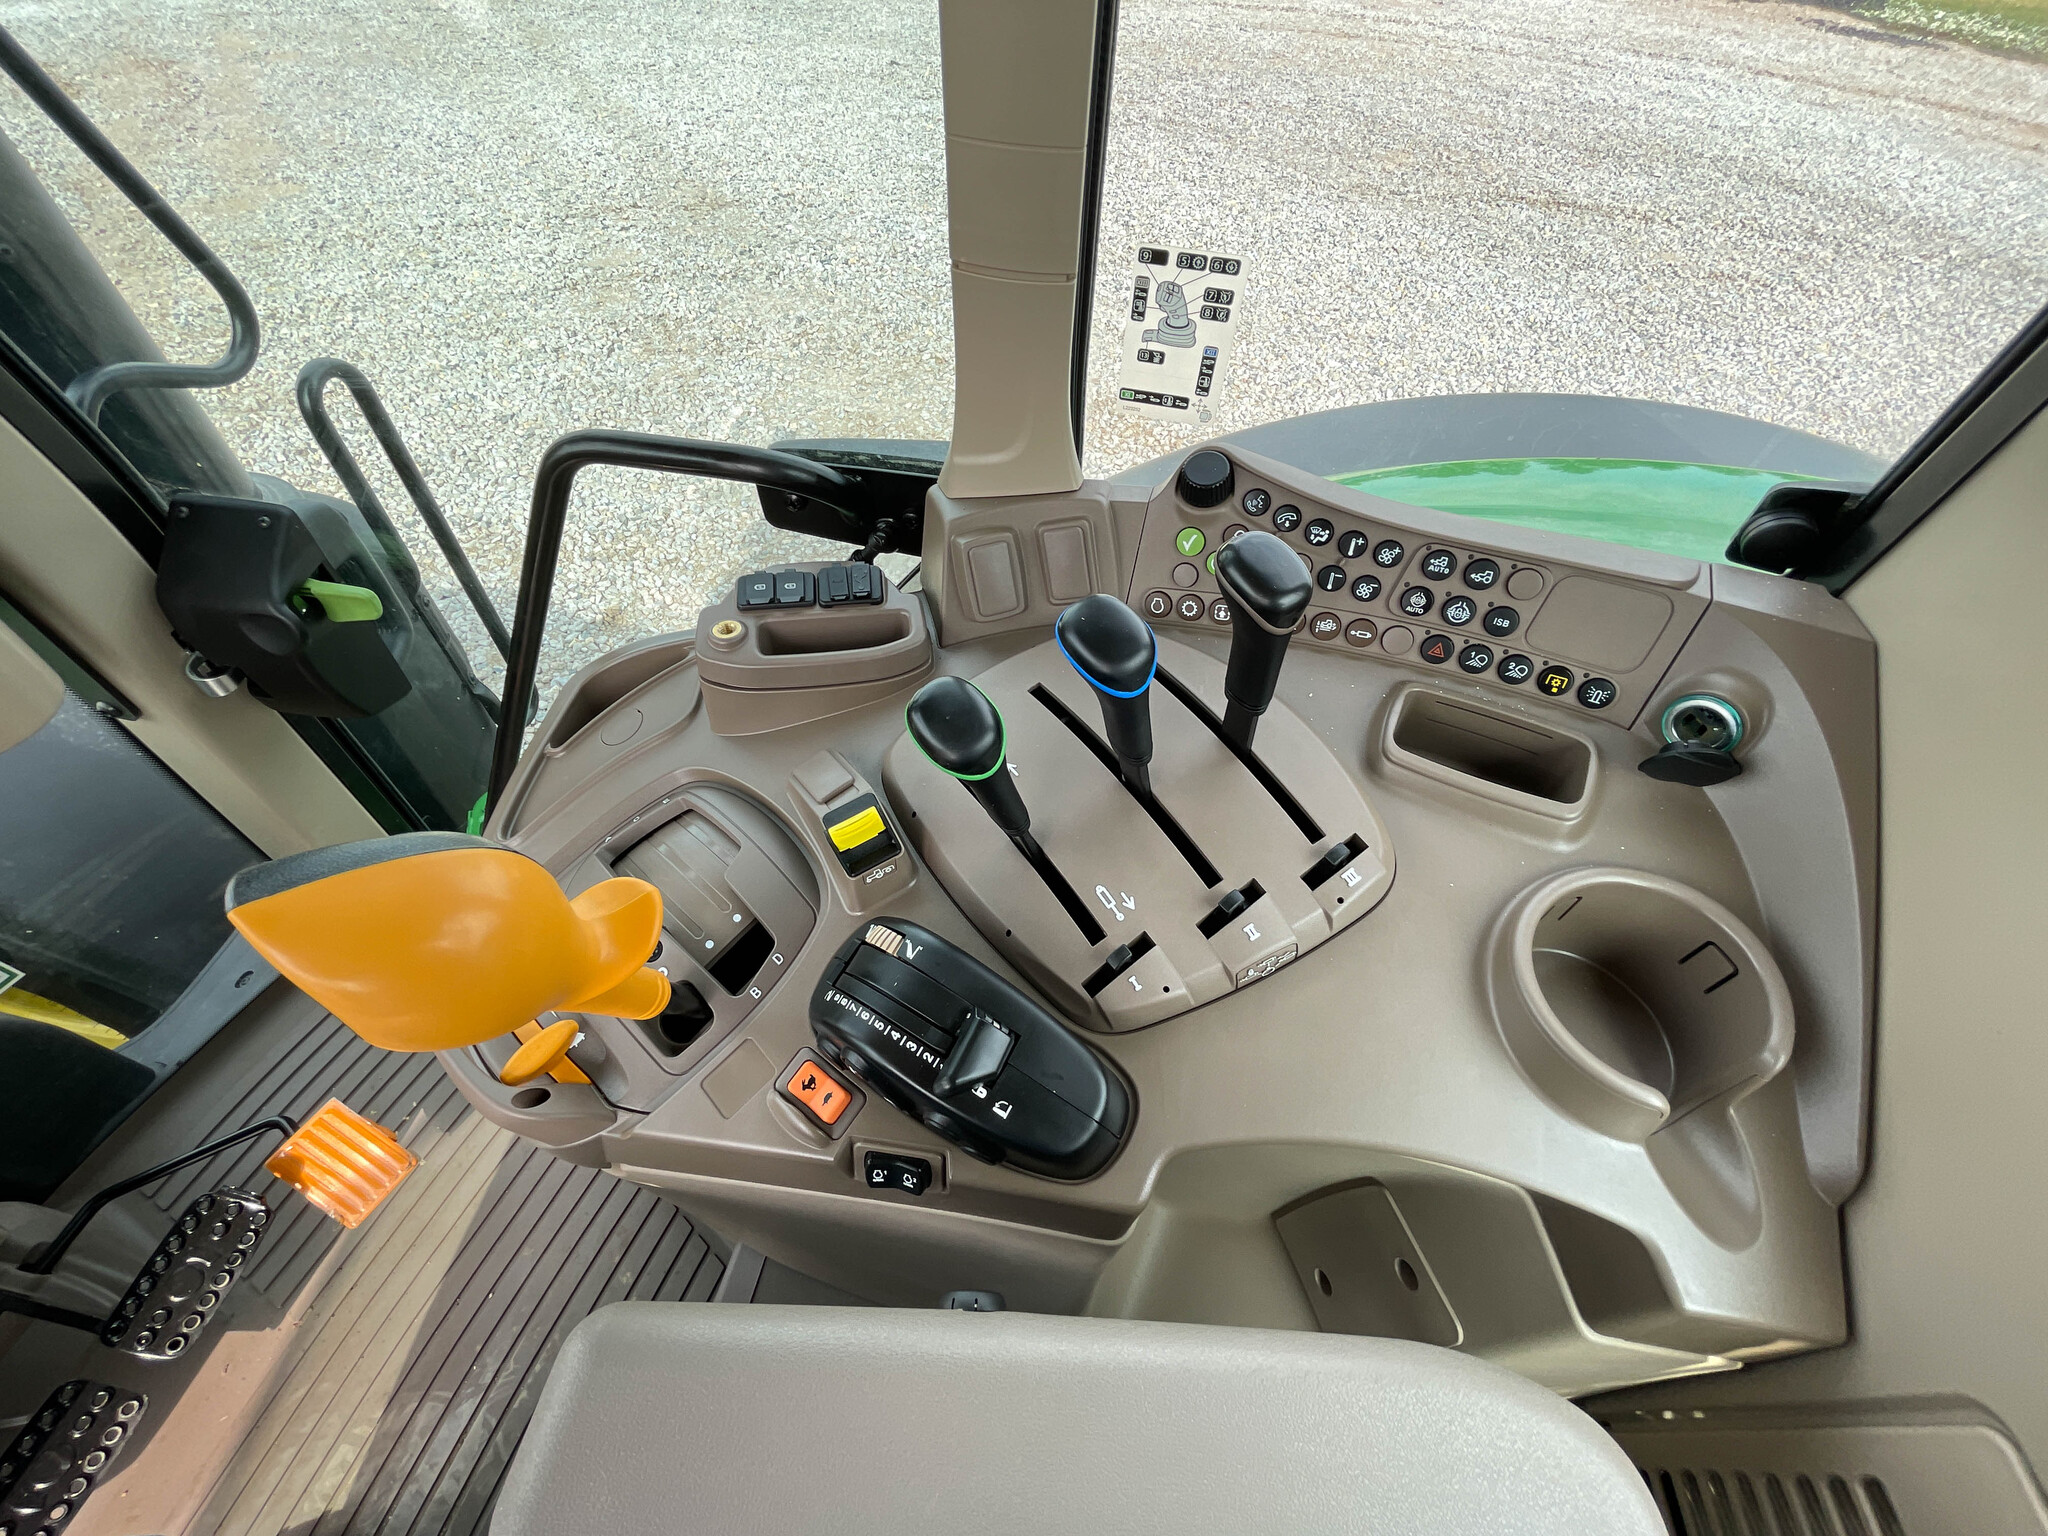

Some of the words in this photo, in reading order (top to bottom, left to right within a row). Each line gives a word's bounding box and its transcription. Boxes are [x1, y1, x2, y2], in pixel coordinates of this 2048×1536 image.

[1428, 564, 1450, 574] AUTO
[1405, 605, 1424, 614] AUTO
[1492, 617, 1511, 628] ISB
[1340, 867, 1362, 887] III
[1242, 922, 1261, 941] II
[772, 953, 784, 965] D
[1128, 975, 1143, 992] I
[750, 986, 762, 999] B
[840, 998, 848, 1006] 8
[849, 1003, 857, 1011] 7
[861, 1011, 870, 1020] 6
[874, 1020, 884, 1031] 5
[891, 1030, 901, 1040] 4
[906, 1041, 917, 1051] 3
[922, 1052, 934, 1063] 2
